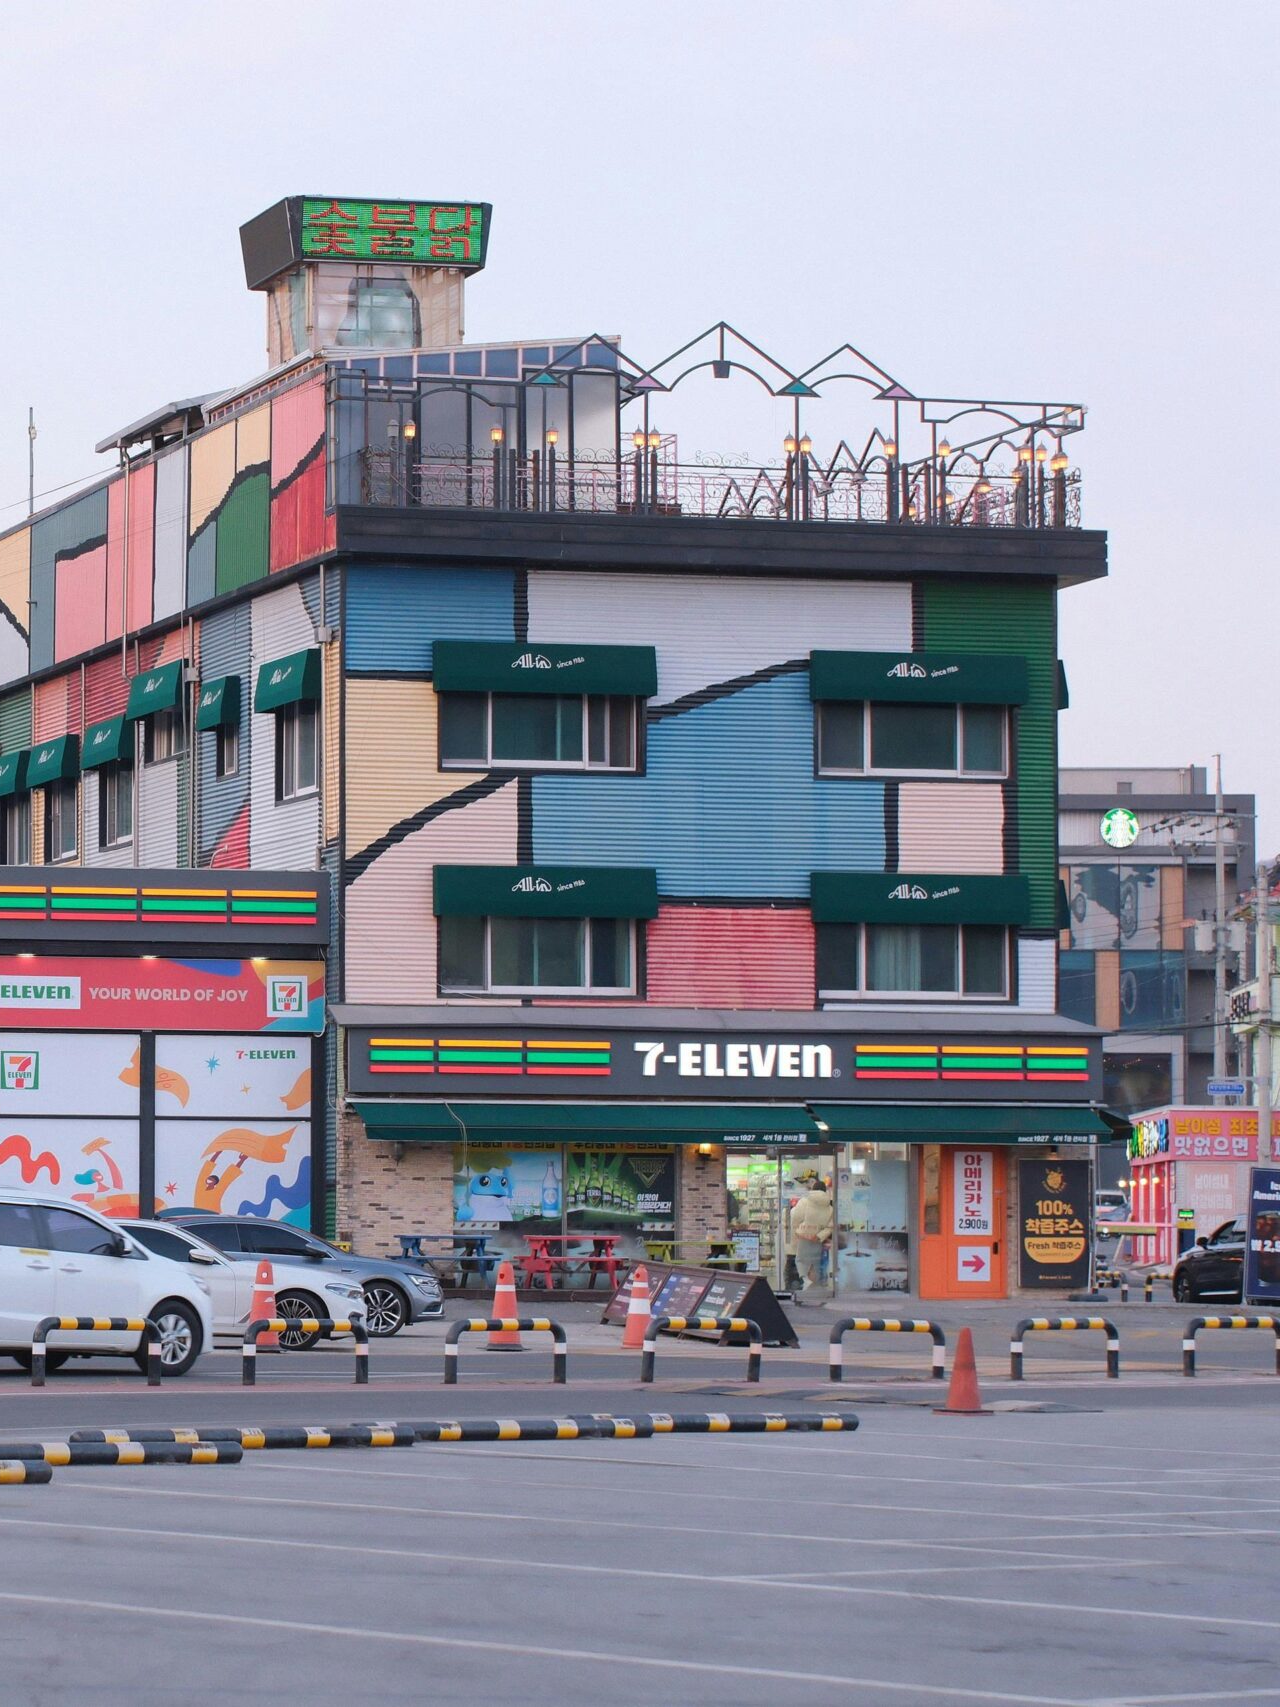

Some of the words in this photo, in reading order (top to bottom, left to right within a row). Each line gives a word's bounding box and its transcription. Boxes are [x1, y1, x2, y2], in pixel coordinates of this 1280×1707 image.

[308, 200, 478, 260] 숯불닭
[88, 986, 132, 1001] YOUR
[134, 987, 191, 1002] WORLD
[194, 988, 214, 1002] OF
[217, 989, 249, 1003] JOY
[1175, 1118, 1222, 1135] 남이섬
[1174, 1136, 1249, 1157] 맛없으면
[963, 1154, 983, 1217] 아메리카노
[1035, 1200, 1073, 1215] 100%
[958, 1218, 988, 1230] 2,900원
[1025, 1218, 1084, 1235] 착즙주스
[1027, 1241, 1050, 1250] Fresh
